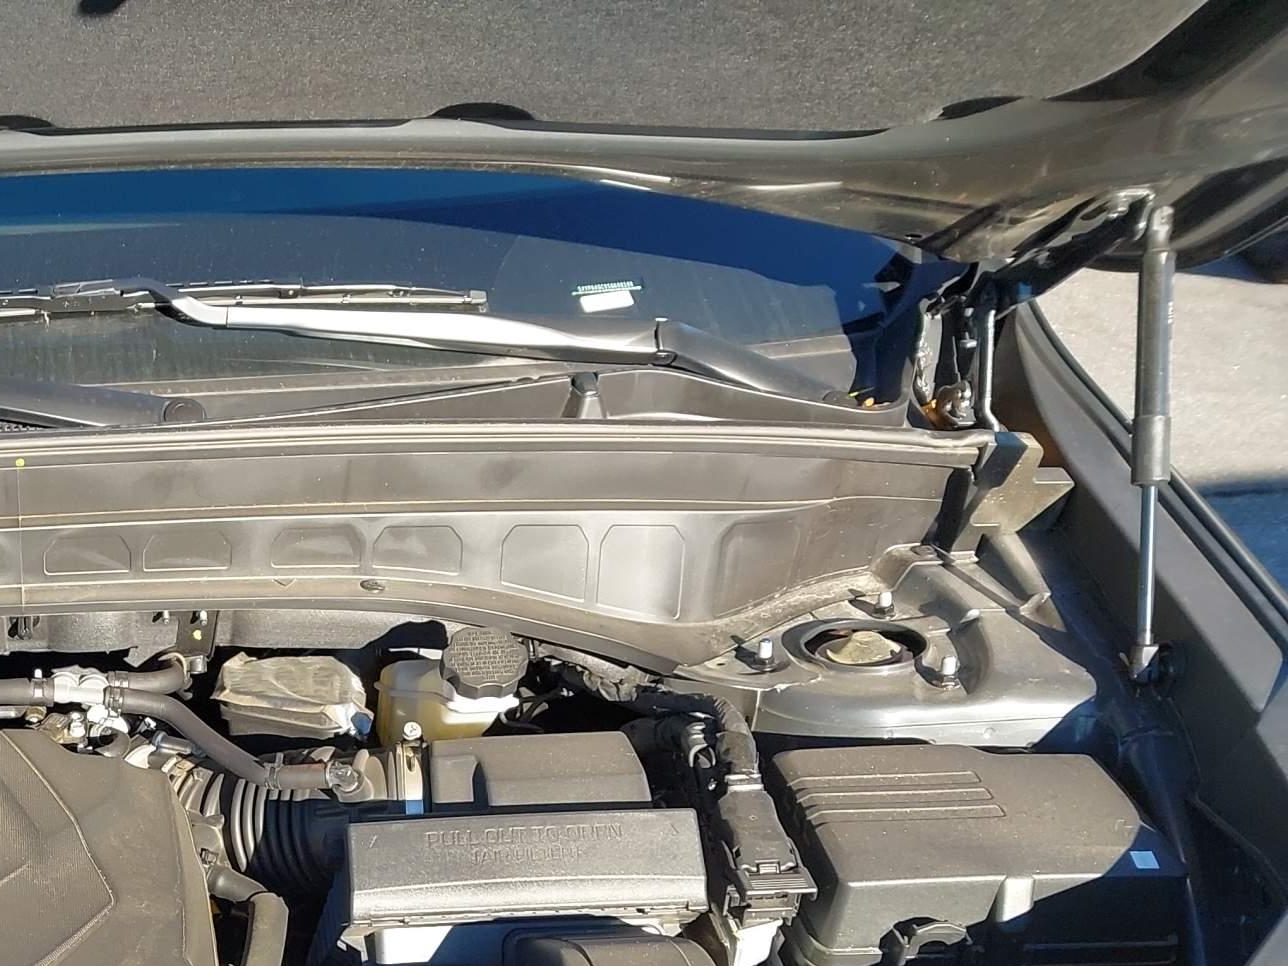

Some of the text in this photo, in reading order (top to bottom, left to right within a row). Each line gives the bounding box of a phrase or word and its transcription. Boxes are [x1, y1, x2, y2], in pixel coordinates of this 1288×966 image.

[423, 823, 623, 848] PULL OUT TO OPEN
